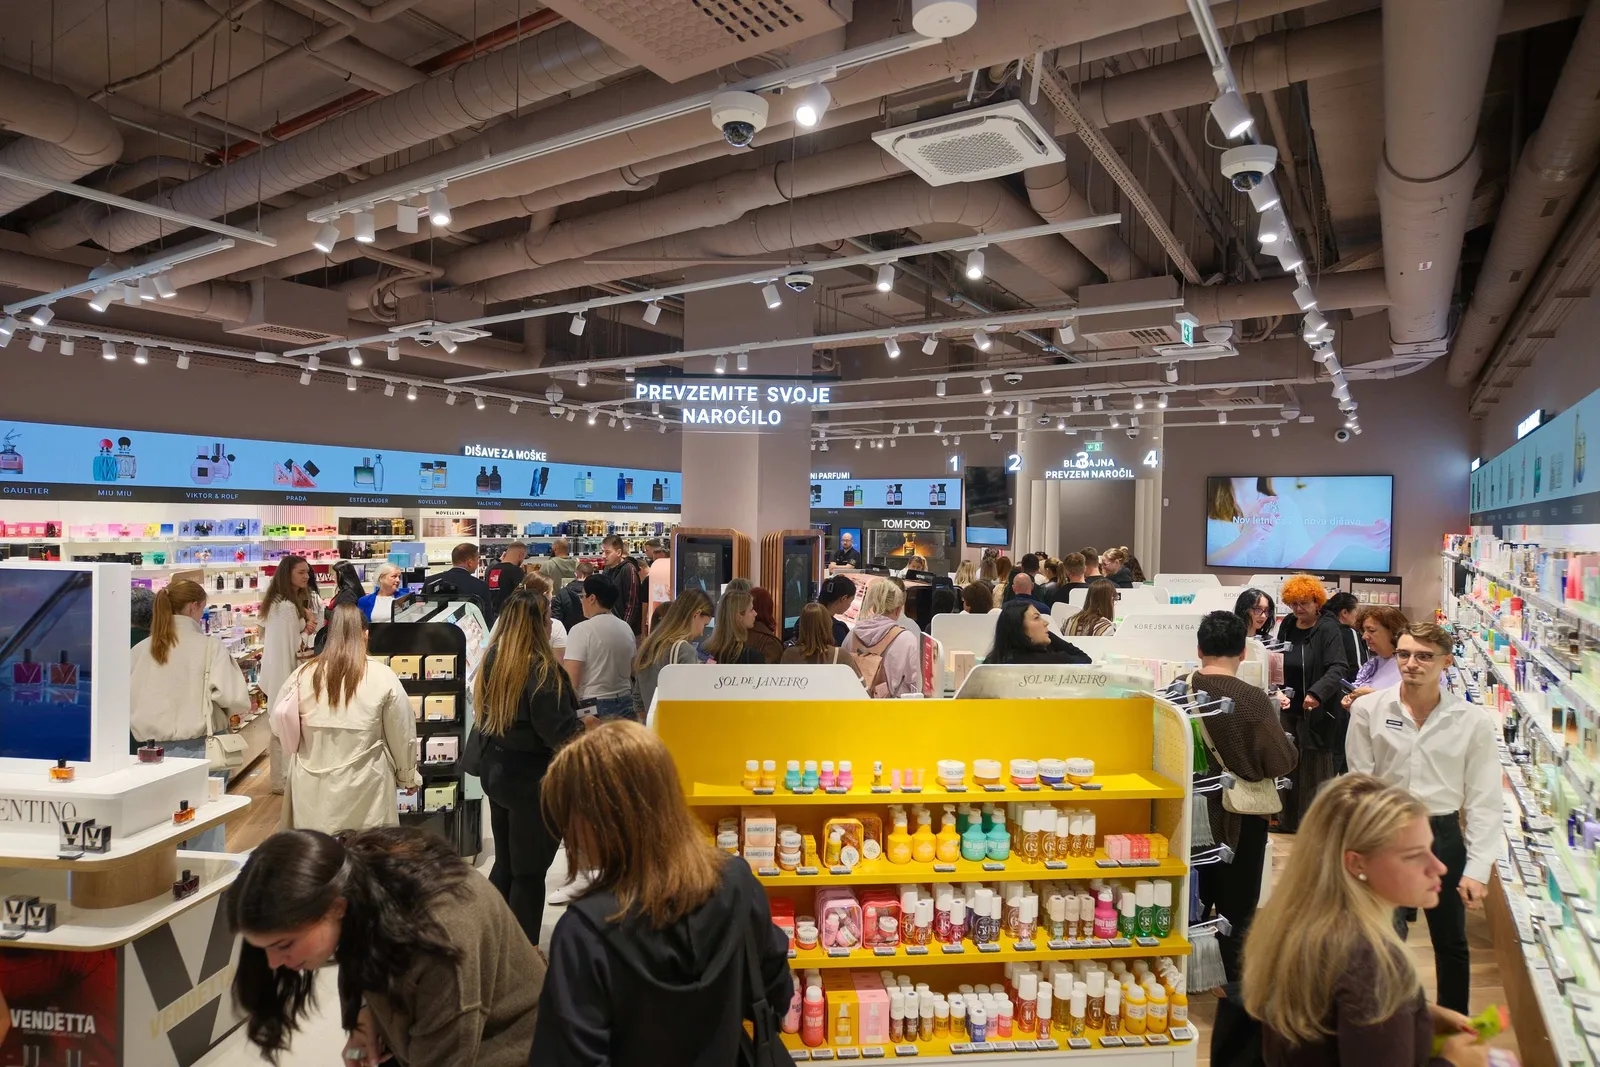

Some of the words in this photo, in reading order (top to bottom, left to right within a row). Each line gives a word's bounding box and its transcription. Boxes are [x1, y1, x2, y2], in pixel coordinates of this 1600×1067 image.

[636, 384, 758, 401] PREVZEMITE
[767, 387, 830, 403] SVOJE
[683, 405, 782, 425] NAROČILO
[464, 444, 500, 458] DIŠAVE
[501, 448, 514, 459] ZA
[515, 449, 547, 461] MOŠKE
[1076, 451, 1089, 469] 3
[1143, 450, 1159, 468] 4
[949, 455, 958, 472] 1
[1008, 454, 1022, 471] 2
[819, 472, 850, 480] PARFUMI
[1045, 470, 1090, 479] PREVZEM
[1091, 468, 1134, 478] NAROČIL
[3, 486, 49, 495] GAULTIER
[882, 519, 902, 529] TOM
[903, 519, 931, 529] FORD
[1232, 516, 1250, 524] Nov
[1304, 517, 1327, 525] nova
[713, 676, 739, 689] SOL
[740, 676, 755, 684] DE
[753, 676, 809, 690] JANEIRO
[1019, 674, 1042, 687] SOL
[1043, 674, 1057, 682] DE
[1056, 674, 1107, 687] JANEIRO
[10, 1009, 96, 1034] VENDETTA
